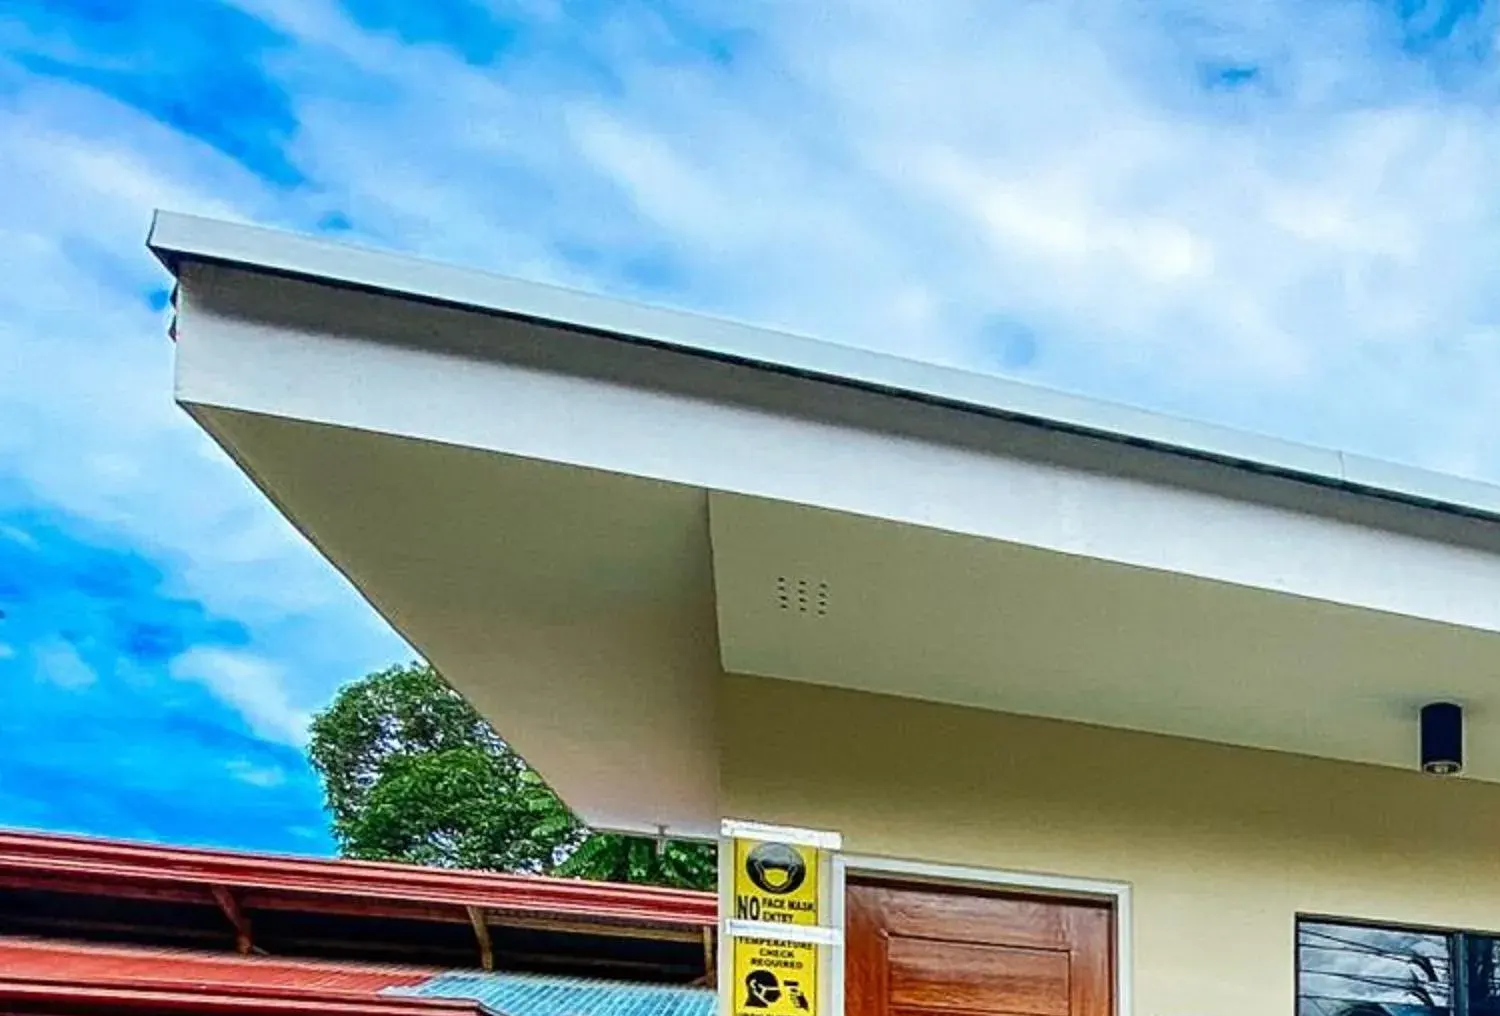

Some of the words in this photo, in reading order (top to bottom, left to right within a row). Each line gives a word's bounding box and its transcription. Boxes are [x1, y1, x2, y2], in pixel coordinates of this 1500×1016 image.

[737, 895, 760, 920] NO
[762, 898, 785, 909] FACE
[787, 900, 816, 911] MASK
[762, 912, 793, 922] ENTRY
[738, 936, 812, 950] TEMPERATURE
[759, 948, 794, 957] CHECK
[751, 958, 803, 969] REQUIRED
